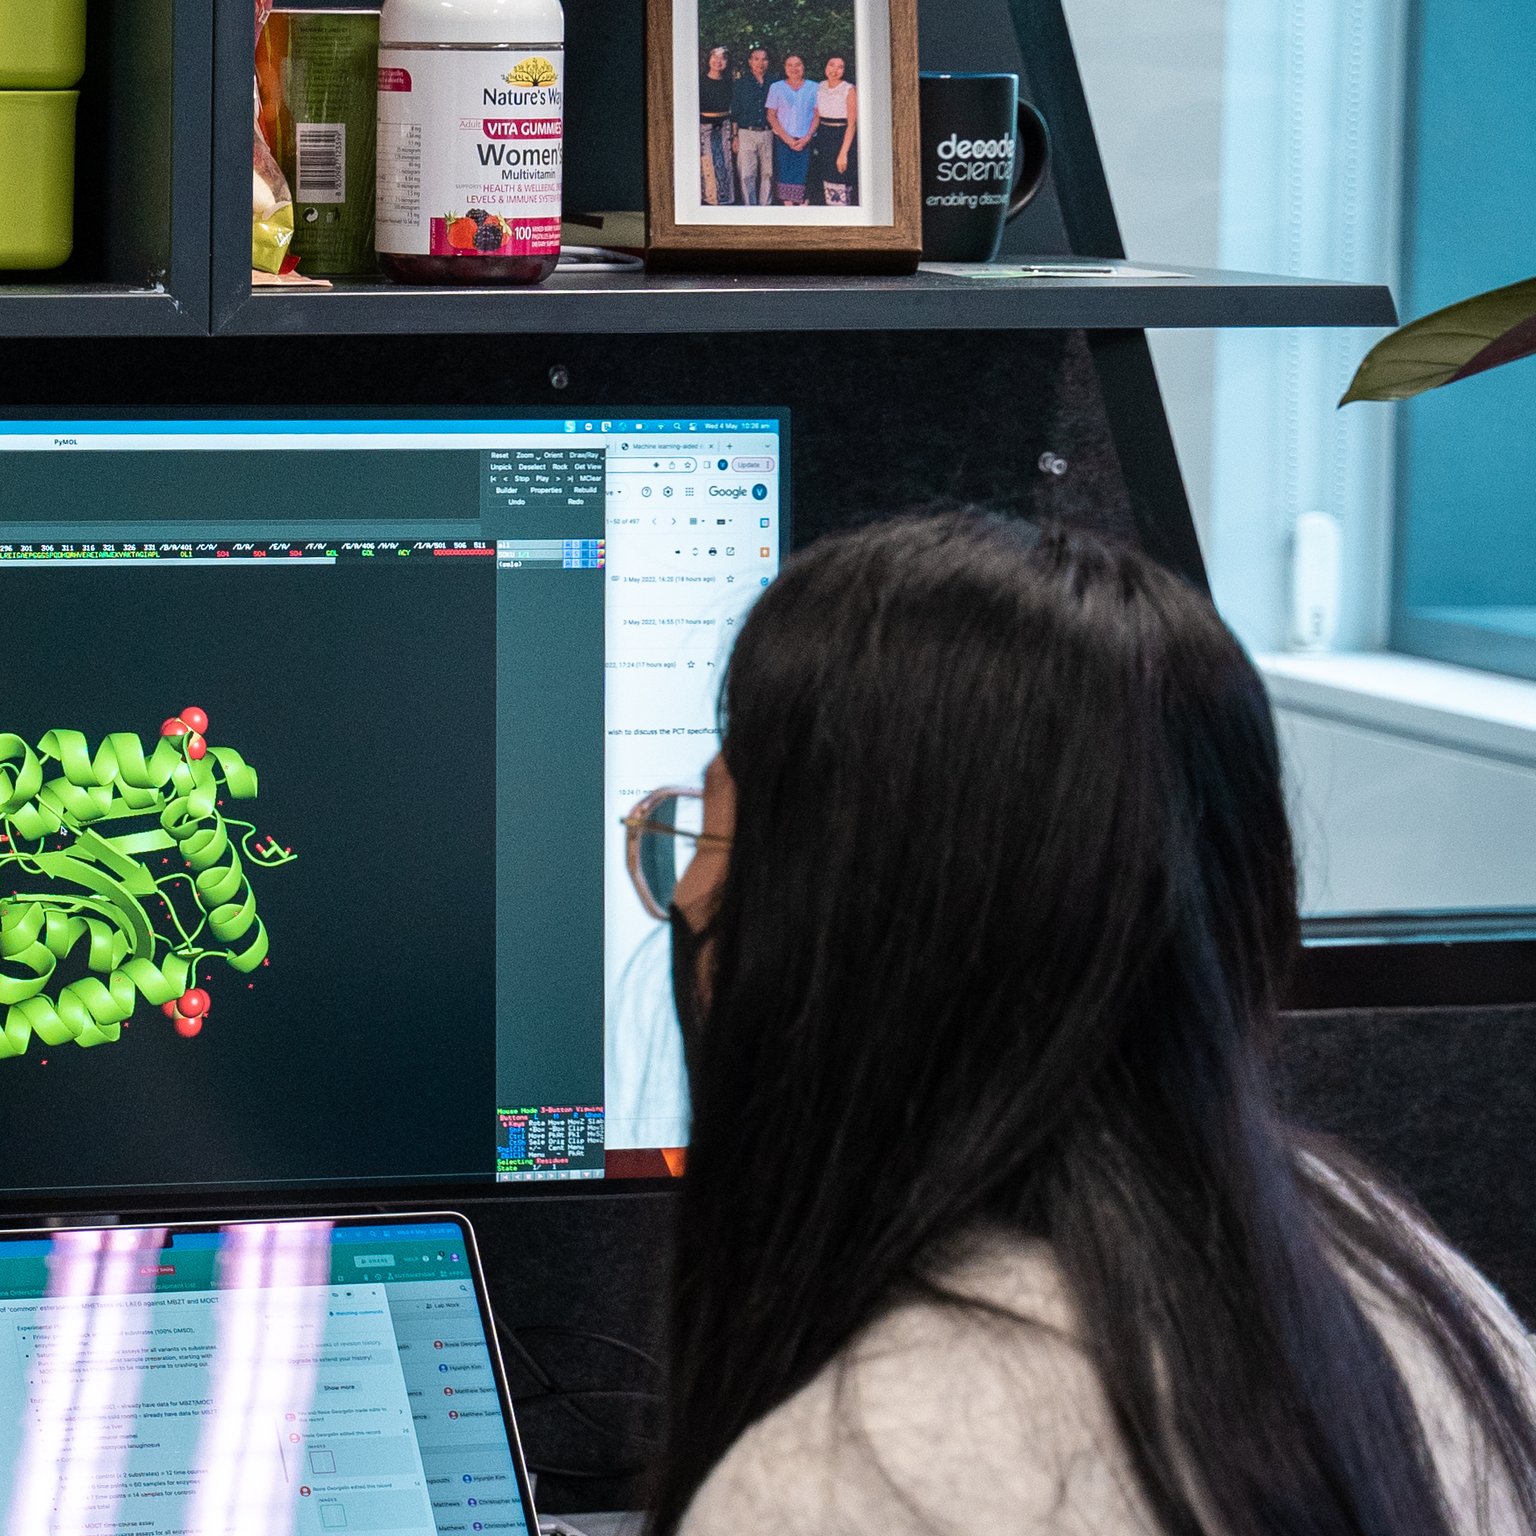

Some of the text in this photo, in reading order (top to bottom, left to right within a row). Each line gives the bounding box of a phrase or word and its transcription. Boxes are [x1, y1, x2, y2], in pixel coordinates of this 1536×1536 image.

[483, 88, 545, 105] Nature's
[460, 120, 481, 128] Adult
[487, 122, 517, 135] VITA
[502, 169, 555, 179] Multivitamin
[467, 195, 495, 203] LEVELS
[498, 195, 504, 203] &
[507, 195, 537, 203] IMMUNE
[926, 192, 978, 208] enabling
[515, 227, 532, 240] 100
[709, 486, 747, 499] Google
